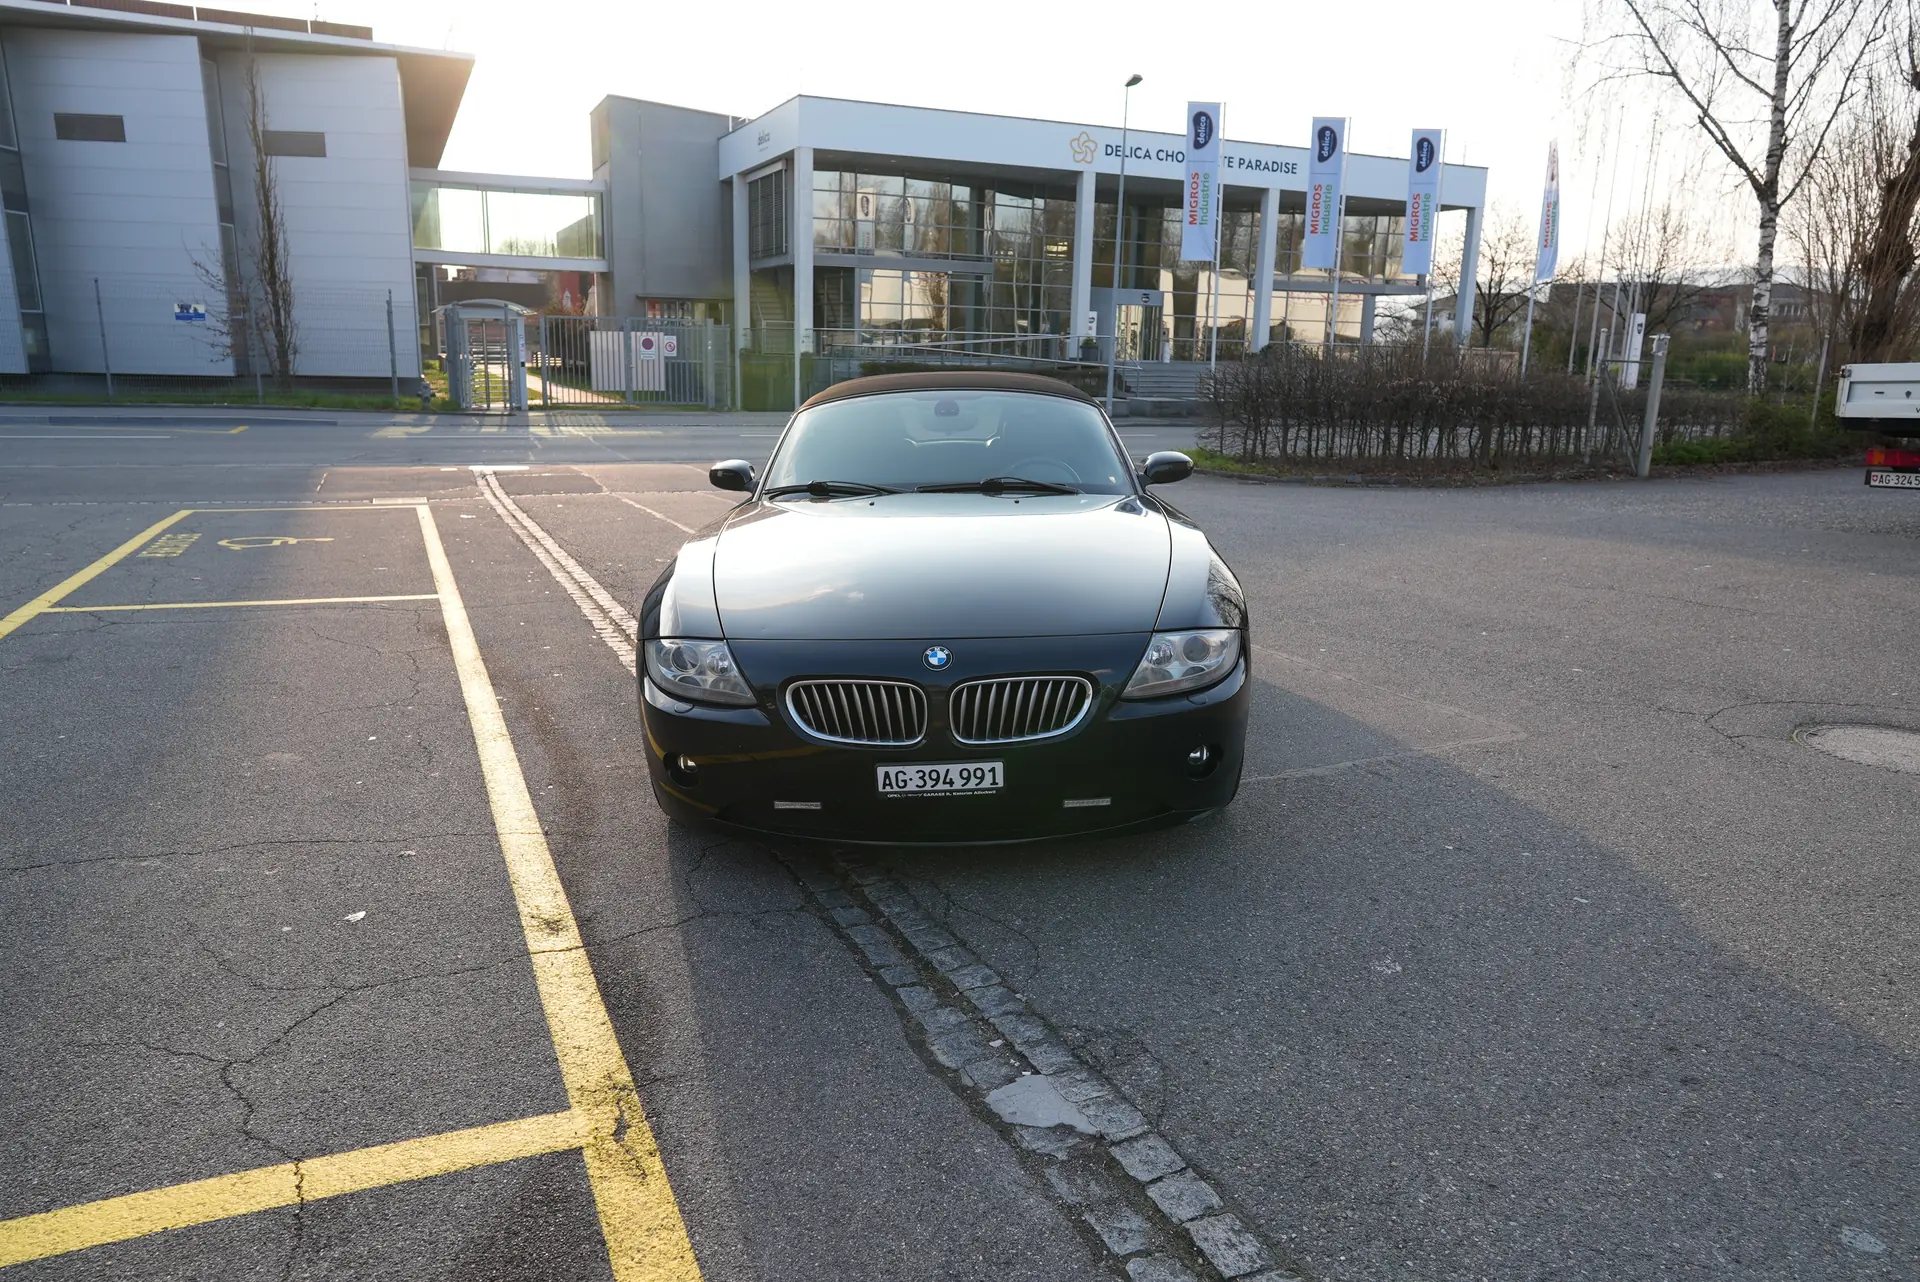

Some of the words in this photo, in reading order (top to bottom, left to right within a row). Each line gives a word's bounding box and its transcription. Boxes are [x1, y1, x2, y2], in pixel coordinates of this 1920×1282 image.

[1197, 116, 1206, 144] delica
[1322, 130, 1330, 157] delica
[1419, 141, 1428, 168] delica
[1238, 157, 1298, 175] PARADISE
[1188, 172, 1200, 225] MIGROS
[1199, 172, 1210, 226] Industrie
[1309, 184, 1323, 235] MIGROS
[1320, 184, 1333, 234] Industrie
[1409, 193, 1421, 242] MIGROS
[1420, 192, 1431, 242] Industrie
[1543, 201, 1552, 249] MIGROS
